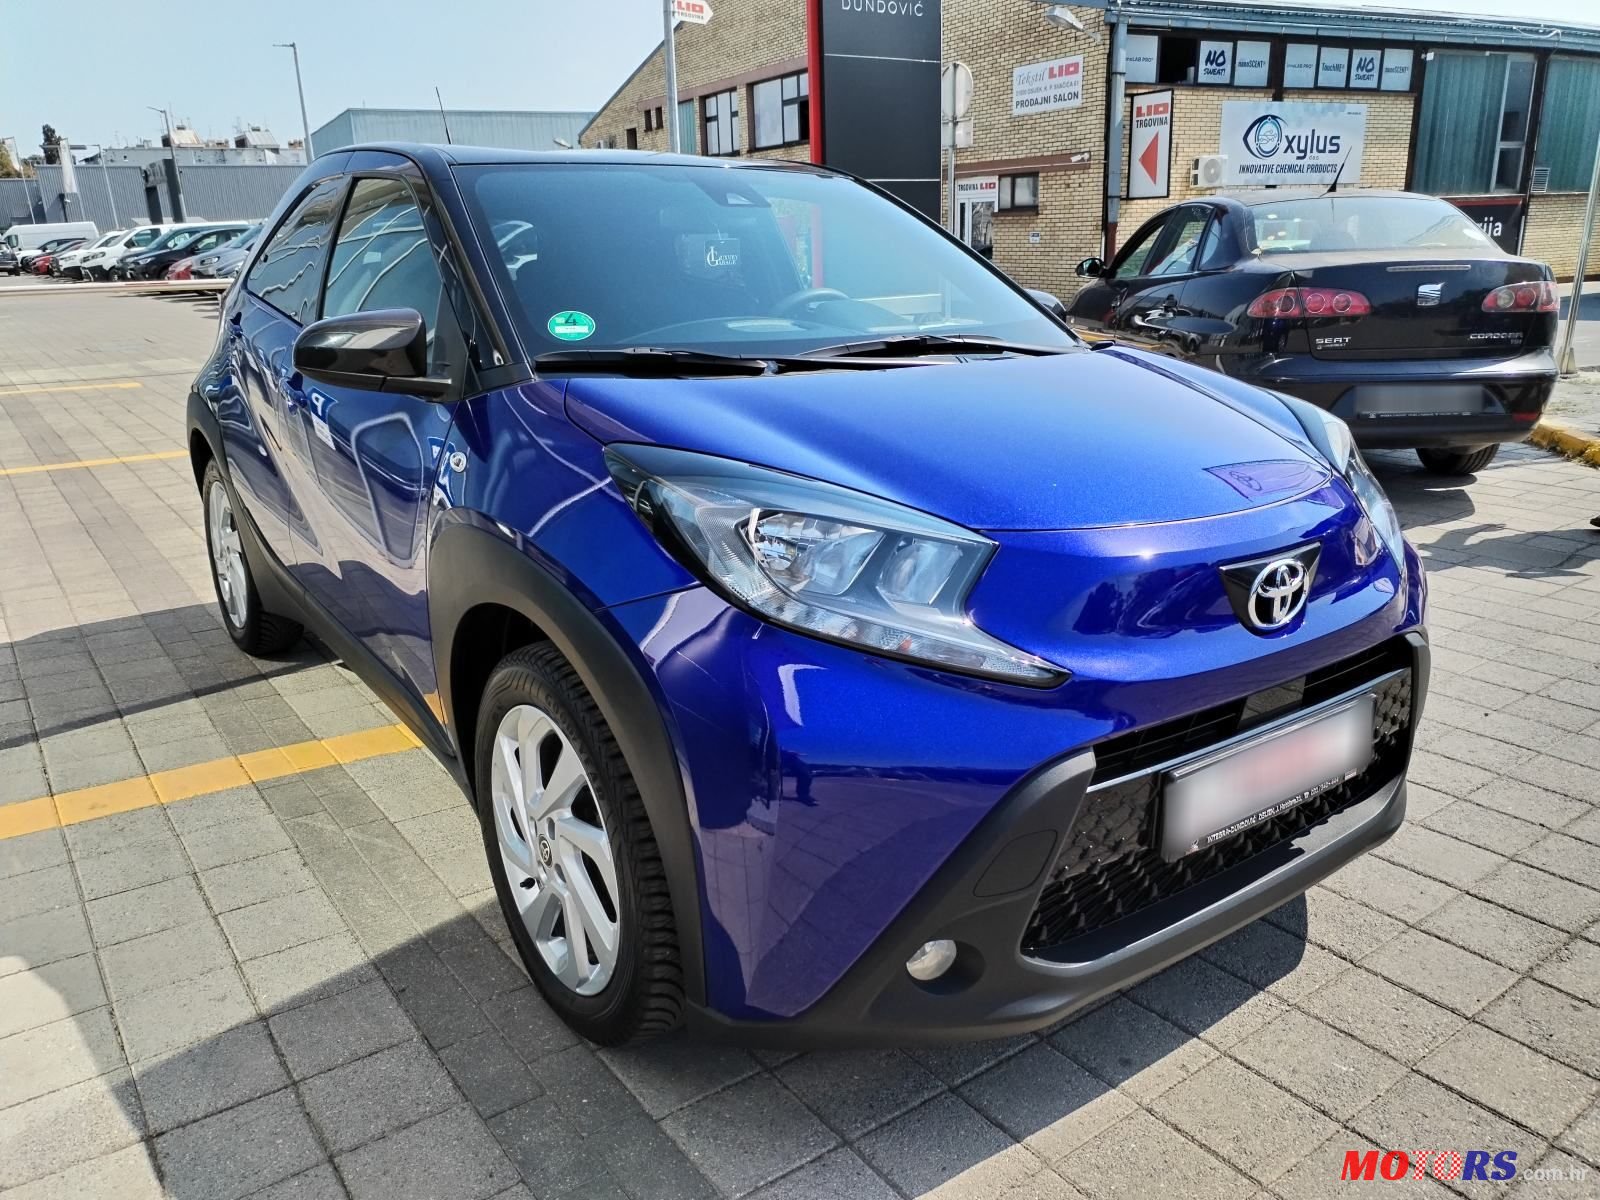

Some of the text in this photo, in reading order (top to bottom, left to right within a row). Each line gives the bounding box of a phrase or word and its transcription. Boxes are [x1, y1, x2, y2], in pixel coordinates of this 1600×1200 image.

[841, 0, 924, 17] DUNDOVIĆ
[1204, 49, 1227, 68] NO
[1355, 57, 1376, 73] NO
[1048, 62, 1080, 79] LIO
[1016, 91, 1079, 109] PRODAJNI SALON
[1135, 102, 1169, 118] LIO
[1135, 116, 1168, 129] TRGOVINA
[1239, 163, 1338, 174] INNOVATIVE CHEMICAL PRODUCTS
[564, 313, 578, 326] 4
